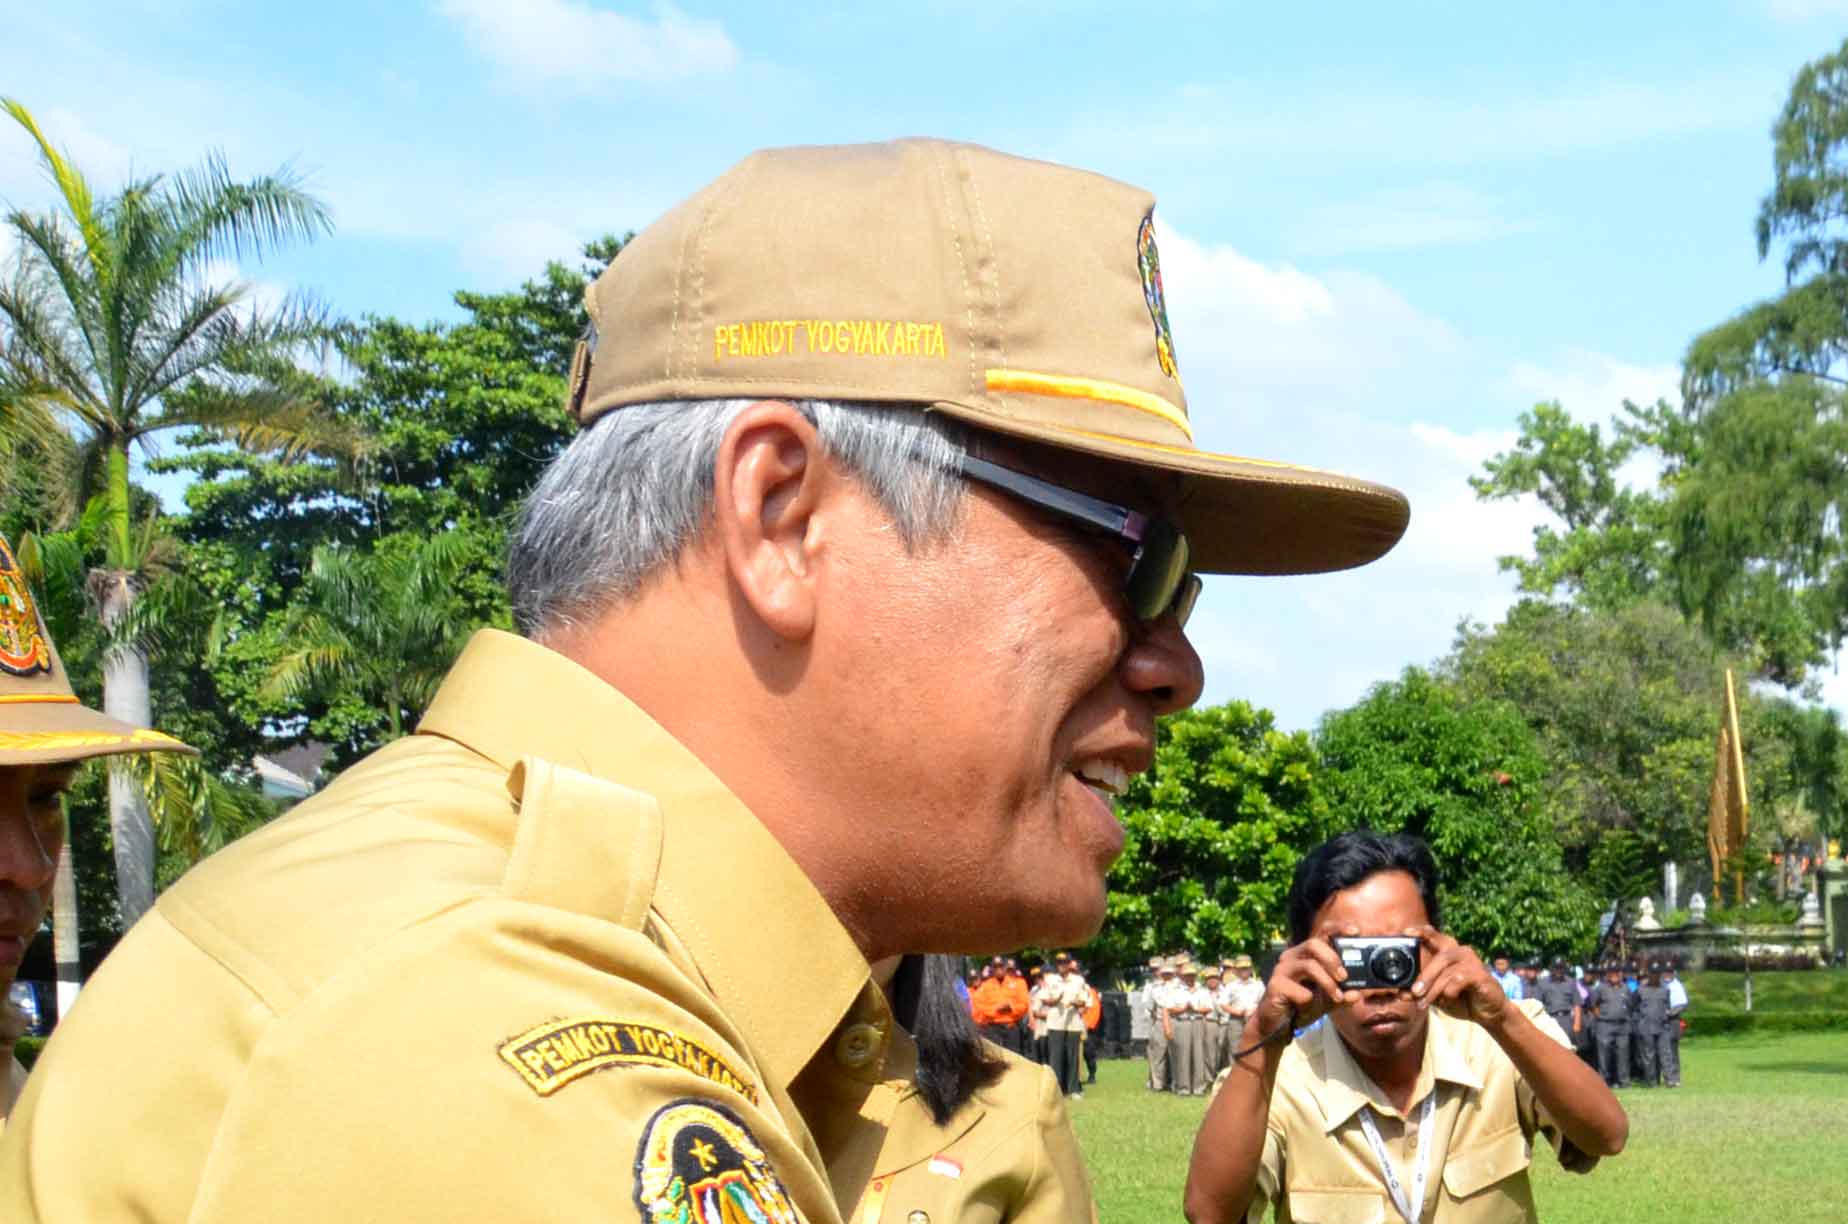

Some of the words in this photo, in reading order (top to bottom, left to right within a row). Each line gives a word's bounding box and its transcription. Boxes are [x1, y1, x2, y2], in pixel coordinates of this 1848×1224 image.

[714, 320, 797, 360] PEMKOT
[804, 320, 946, 358] YOGYAKARTA
[522, 1024, 621, 1084] PEMKOT
